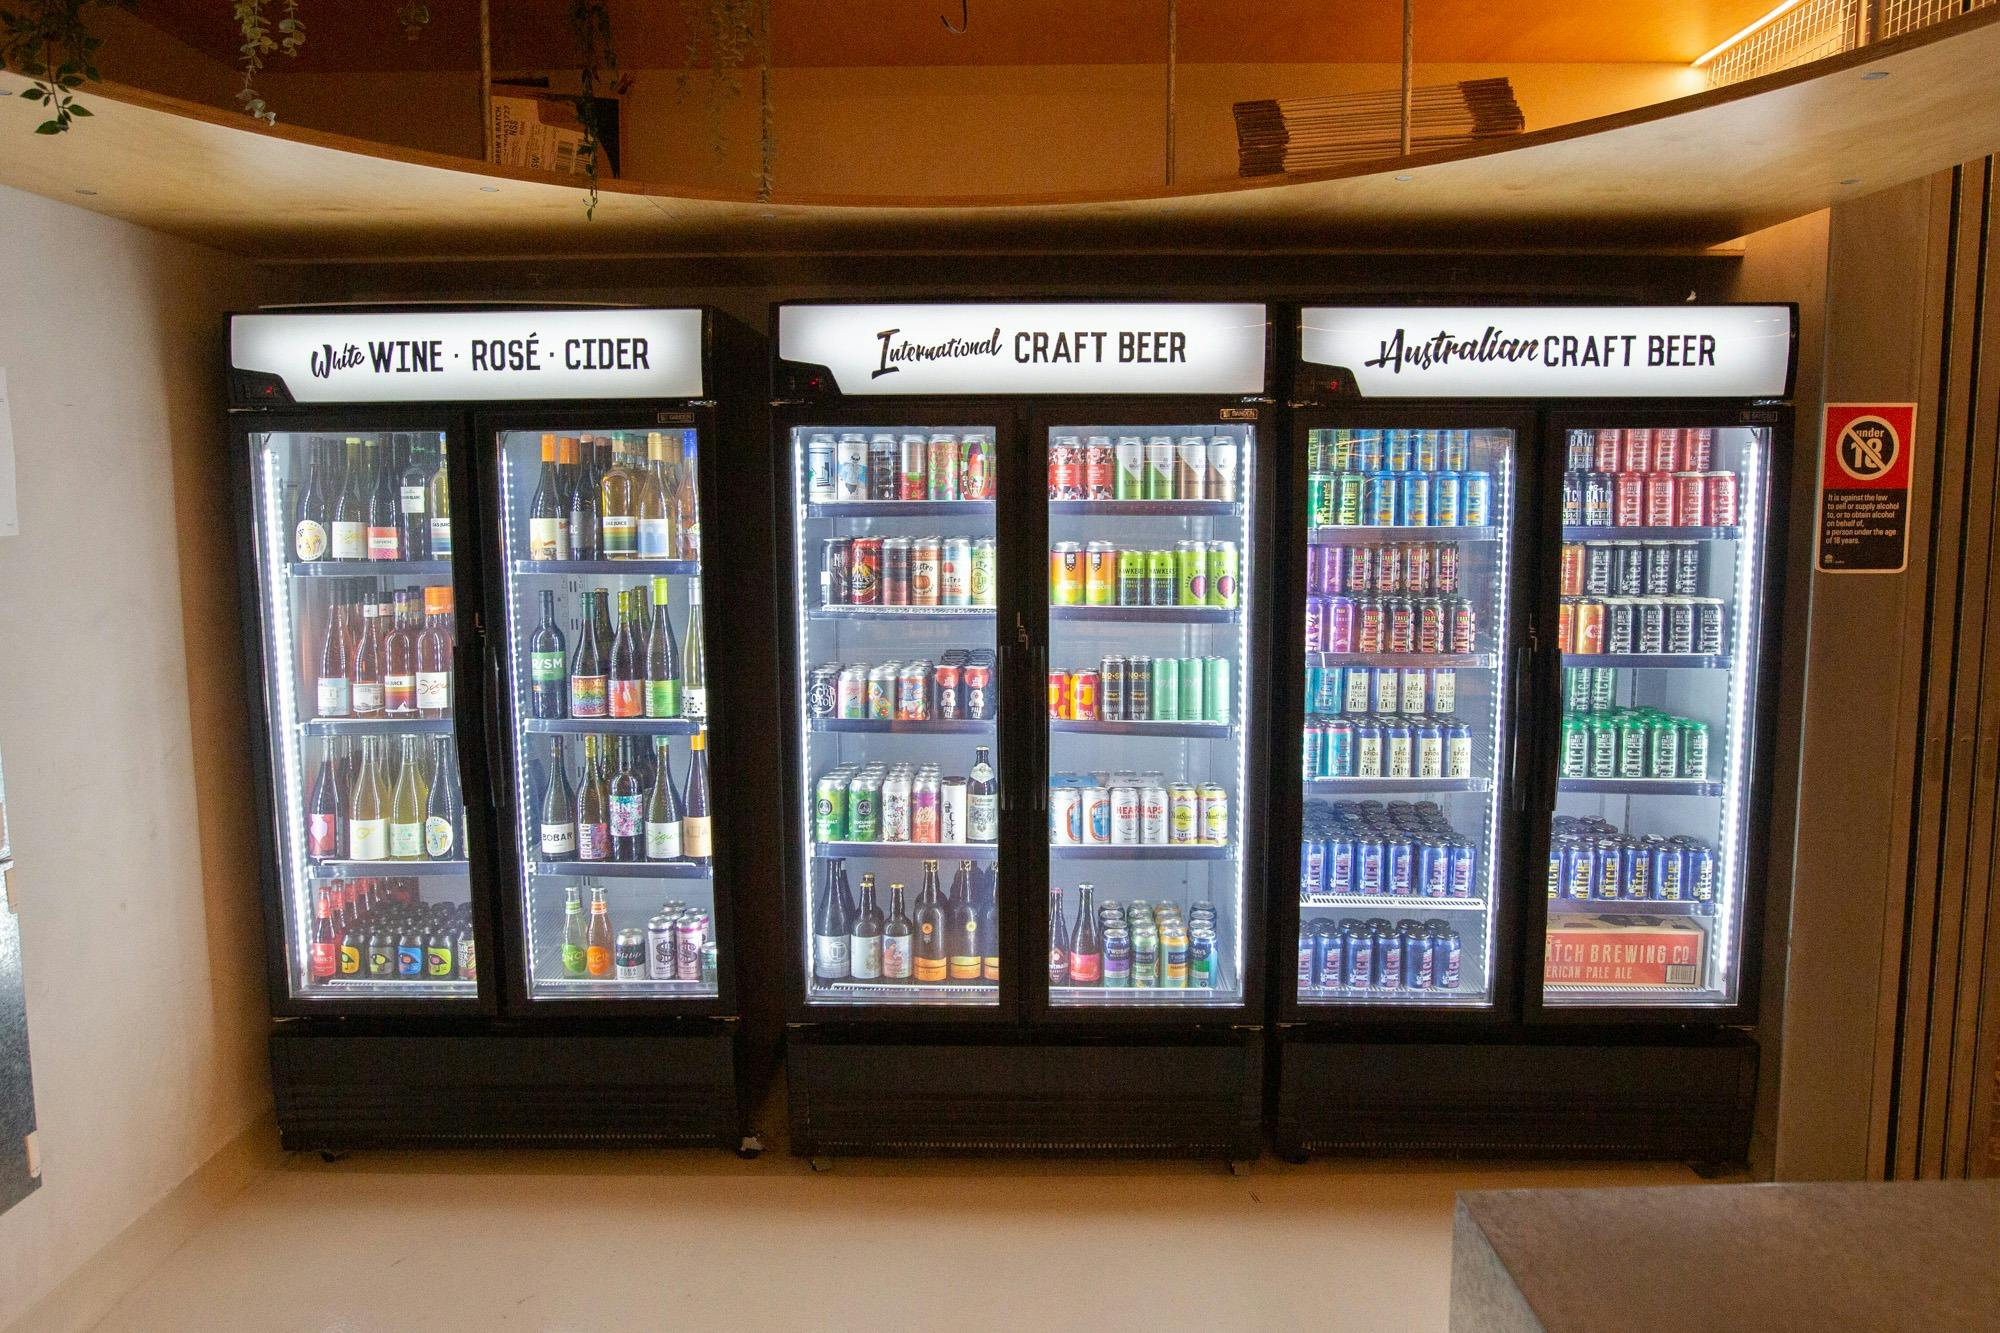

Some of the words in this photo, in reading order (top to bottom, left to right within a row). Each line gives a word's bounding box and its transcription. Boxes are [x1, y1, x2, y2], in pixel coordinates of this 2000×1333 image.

[310, 342, 365, 379] White
[368, 340, 444, 373] WINE
[471, 332, 541, 371] ROSÉ
[565, 337, 650, 371] CIDER
[871, 327, 1003, 380] International
[1014, 331, 1108, 364] CRAFT
[1118, 331, 1187, 364] BEER
[1364, 325, 1539, 374] Australian
[1543, 334, 1637, 367] CRAFT
[1647, 334, 1716, 367] BEER
[1850, 438, 1884, 469] 18
[1546, 943, 1584, 962] ATCH
[1590, 944, 1666, 964] BREWING
[1546, 965, 1580, 979] ERICAN
[1586, 966, 1609, 979] PALE
[1615, 966, 1633, 979] ALE
